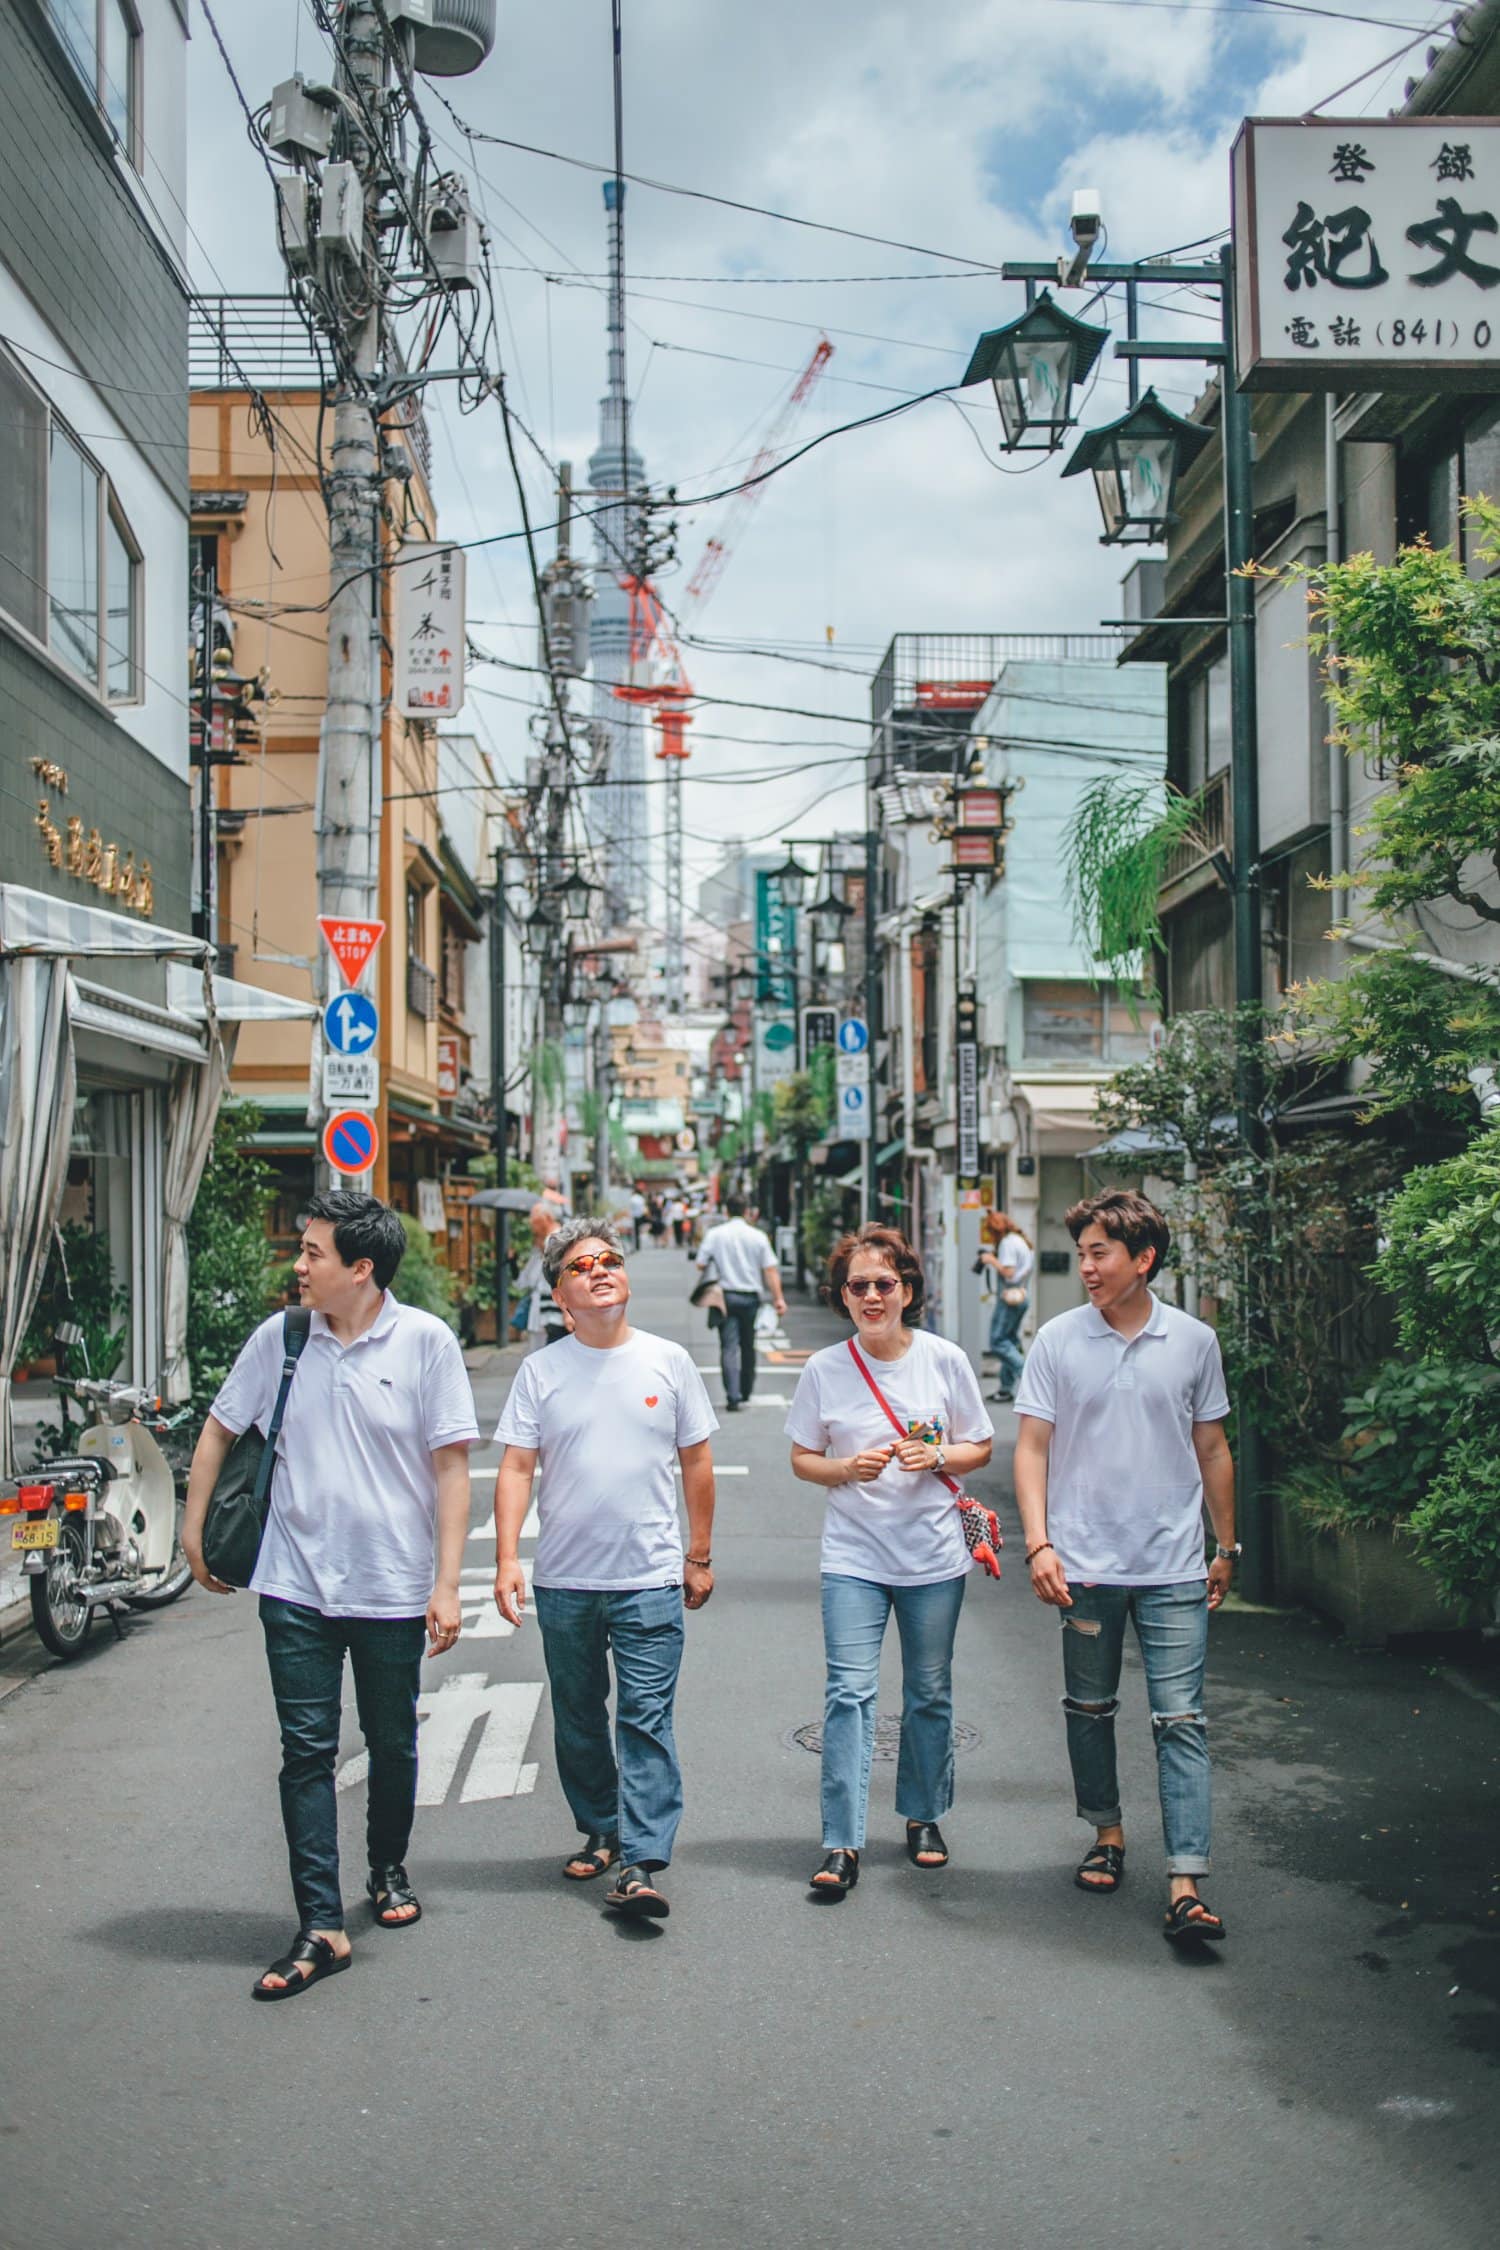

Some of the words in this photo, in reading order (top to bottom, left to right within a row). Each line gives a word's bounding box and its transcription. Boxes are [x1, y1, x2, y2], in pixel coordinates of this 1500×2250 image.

[1327, 141, 1476, 184] 登録
[1281, 196, 1500, 292] 紀文
[332, 926, 373, 944] 止まれ
[339, 945, 367, 960] STOP
[327, 1077, 374, 1090] 一方通行
